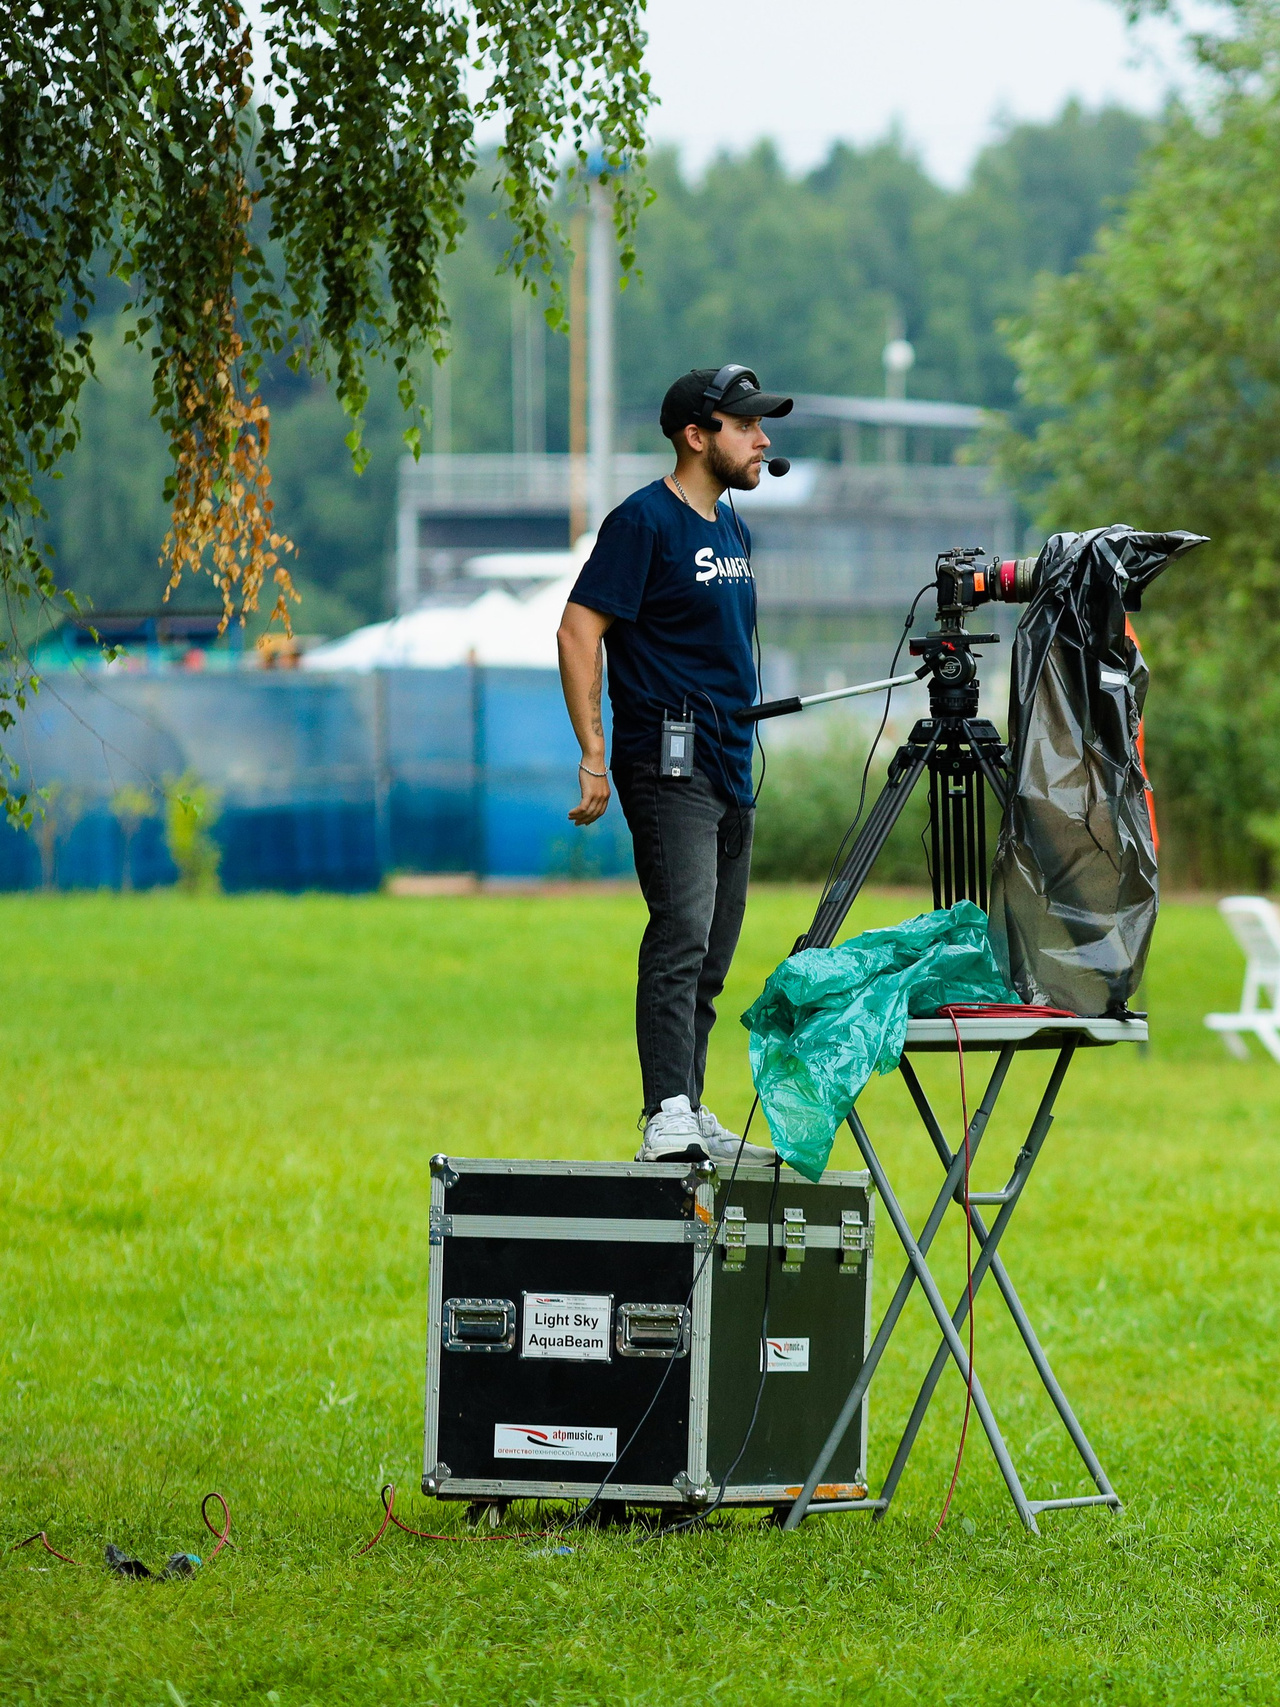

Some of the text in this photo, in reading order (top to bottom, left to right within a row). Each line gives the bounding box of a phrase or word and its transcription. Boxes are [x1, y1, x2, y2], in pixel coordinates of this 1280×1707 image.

[535, 1312, 599, 1330] Light Sky
[528, 1333, 604, 1349] AquaBeam
[552, 1429, 604, 1442] atpmusic.ru
